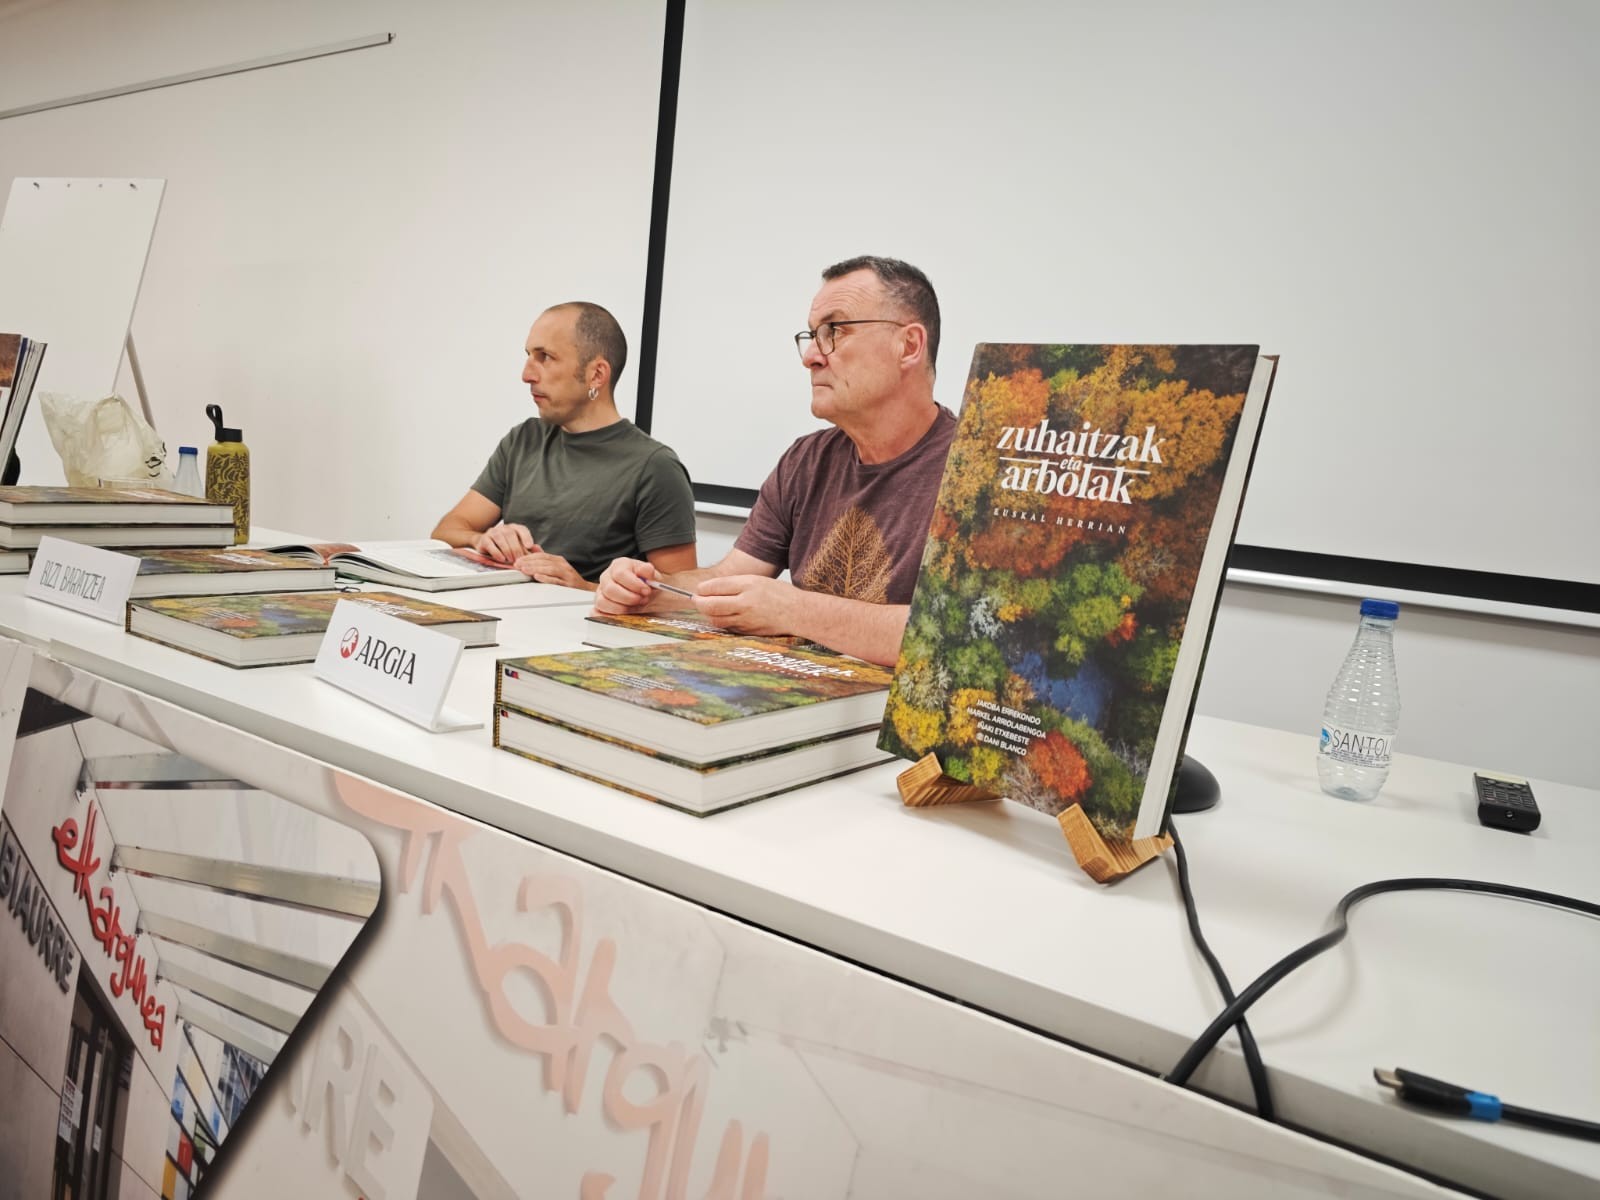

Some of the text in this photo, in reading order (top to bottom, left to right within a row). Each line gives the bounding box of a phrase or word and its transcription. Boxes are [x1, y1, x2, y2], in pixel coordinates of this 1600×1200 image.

[996, 419, 1166, 464] zuhaitzak
[1060, 457, 1083, 471] eta
[1001, 459, 1135, 504] arbolak
[993, 507, 1126, 534] EUSKAL HERRIAN
[40, 560, 62, 589] BIZI
[355, 635, 416, 685] ARGIA
[967, 707, 1046, 739] MARKEL ARRIOLABENGOA
[976, 699, 1041, 725] JAKOBA ERREKONDO
[984, 735, 1027, 756] DANI BLANCO
[994, 727, 1030, 745] ETXEBESTE
